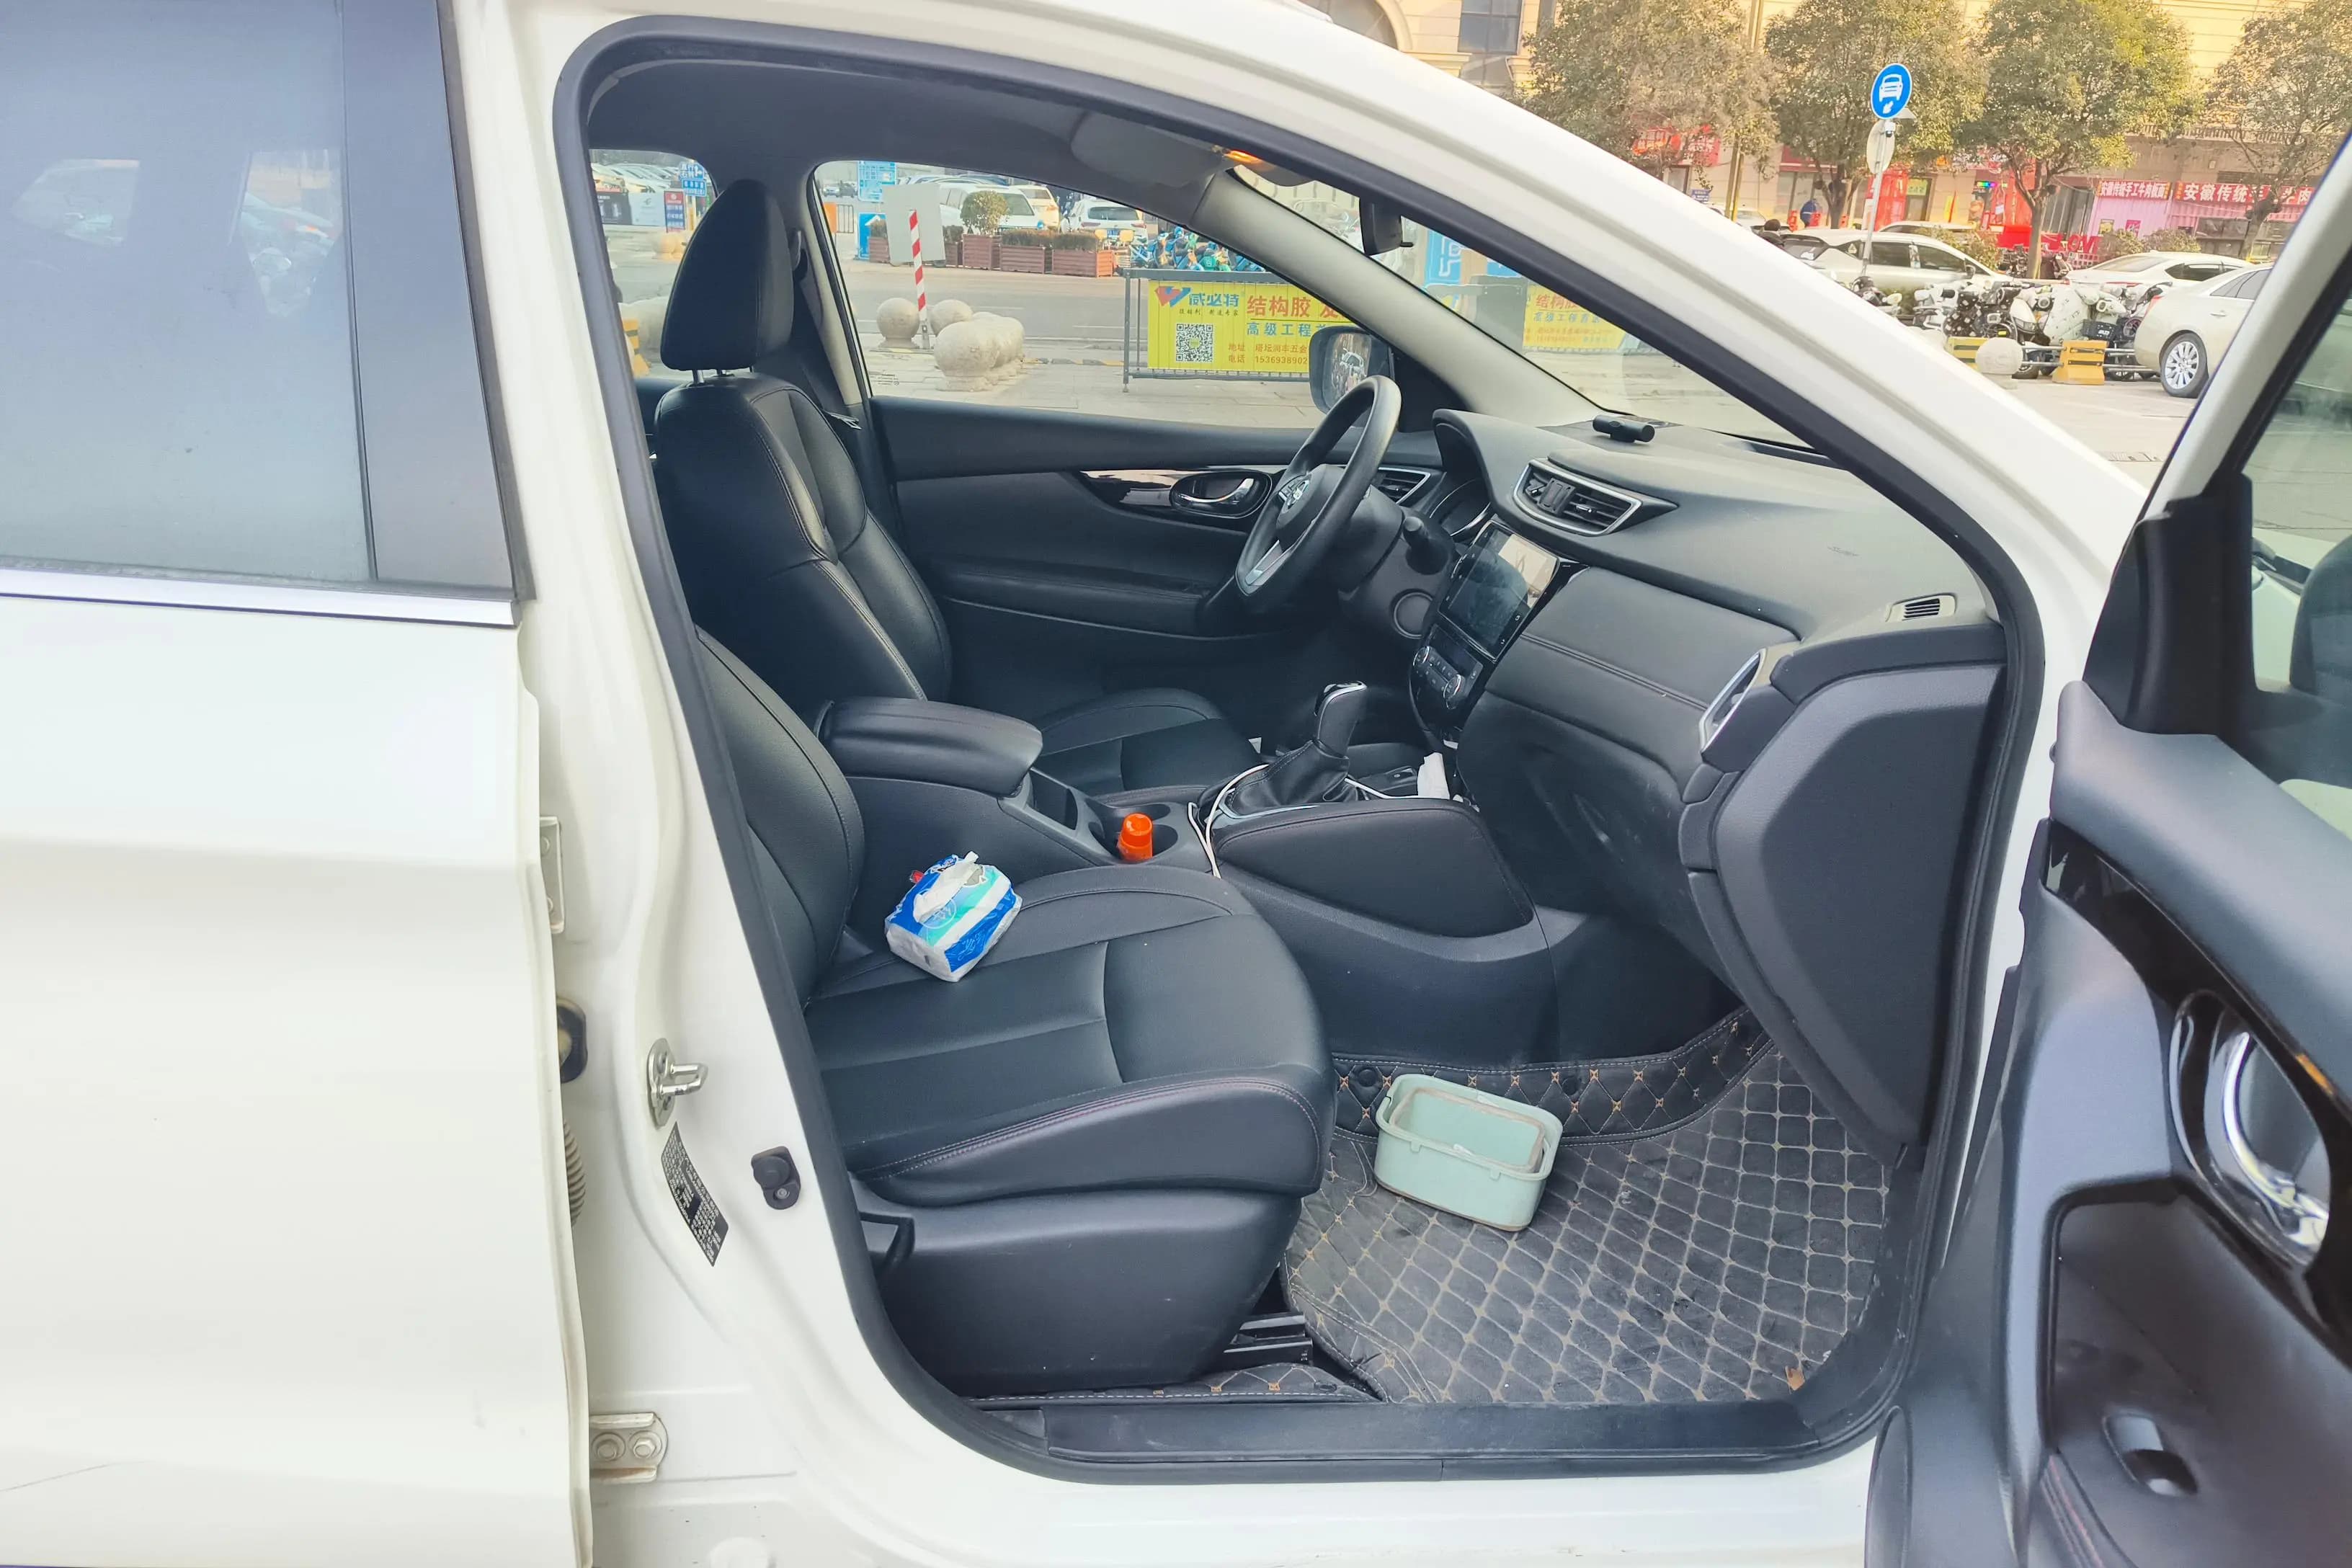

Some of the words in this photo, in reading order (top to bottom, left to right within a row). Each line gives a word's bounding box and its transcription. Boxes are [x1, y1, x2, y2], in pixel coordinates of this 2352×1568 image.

[1189, 293, 1239, 307] 威必特
[1247, 295, 1311, 317] 结构胶
[1247, 322, 1326, 337] 高级工程
